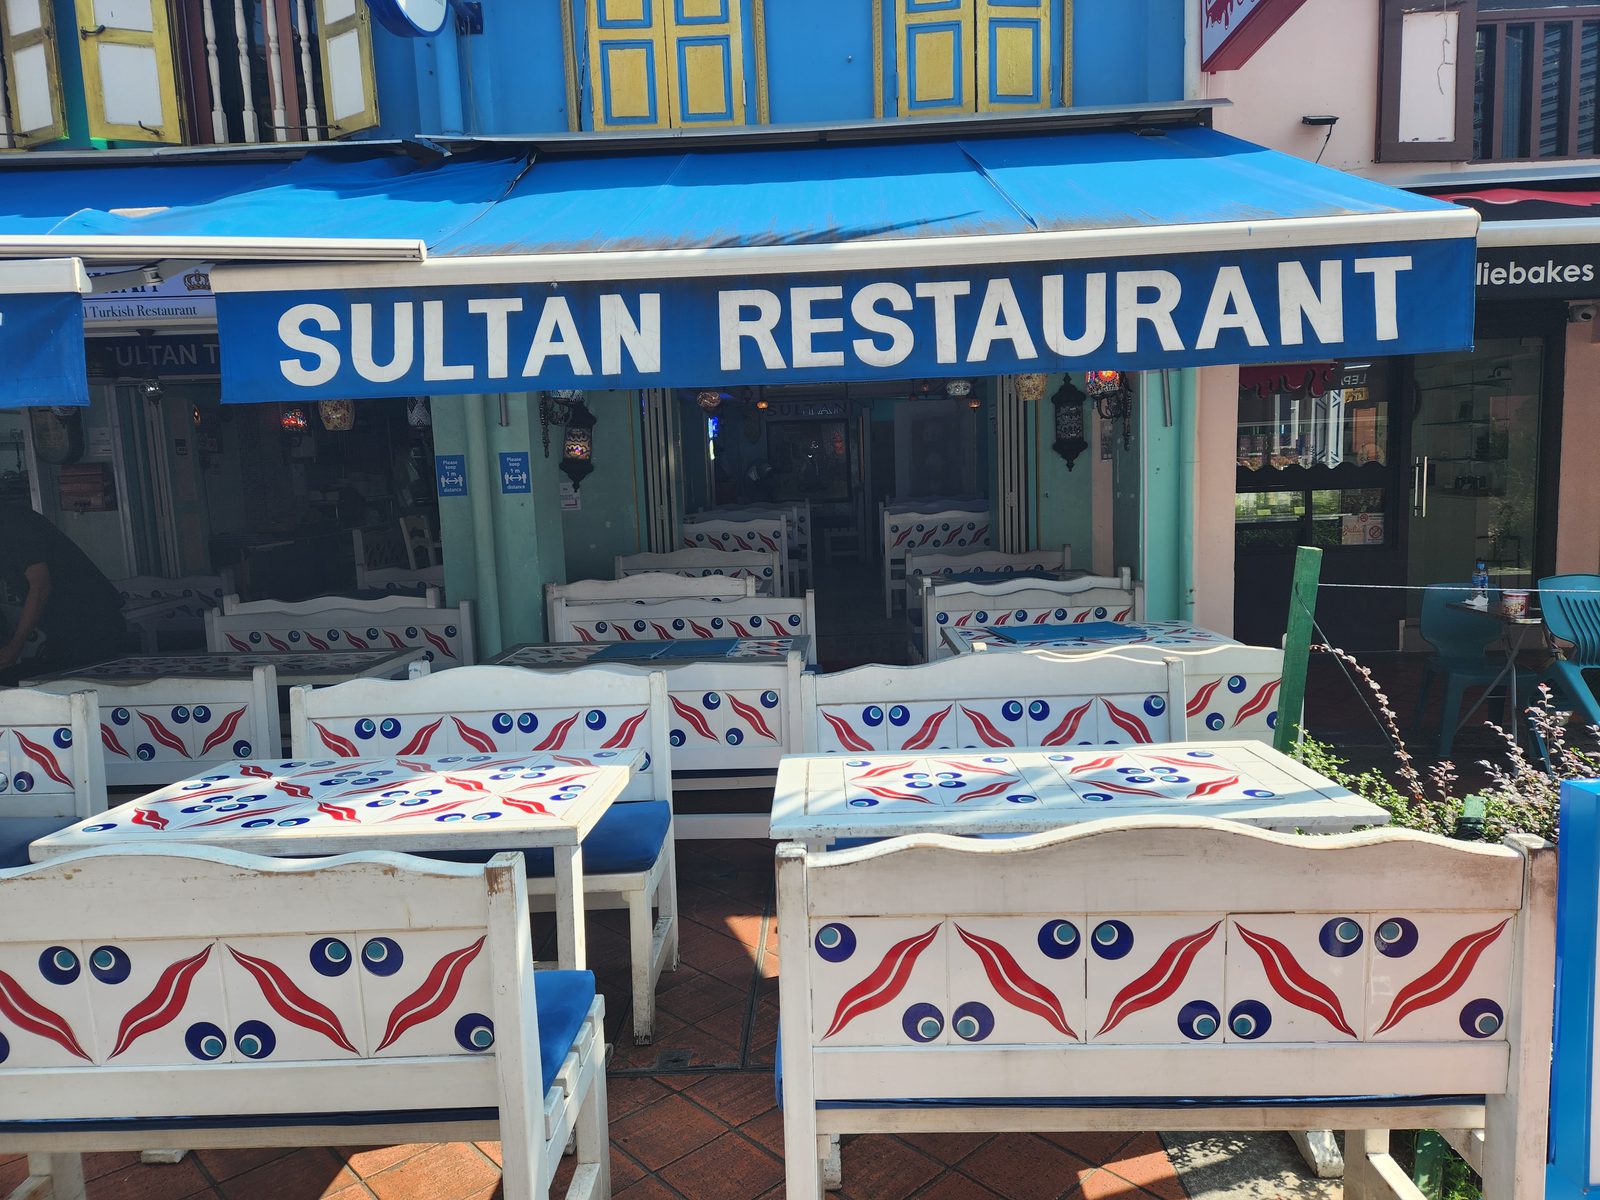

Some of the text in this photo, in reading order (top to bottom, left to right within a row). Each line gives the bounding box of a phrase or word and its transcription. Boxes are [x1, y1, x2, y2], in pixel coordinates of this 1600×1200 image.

[90, 306, 134, 318] Turkish
[137, 304, 198, 317] Restaurant
[277, 256, 1413, 386] SULTAN RESTAURANT
[106, 343, 197, 366] ULTAN
